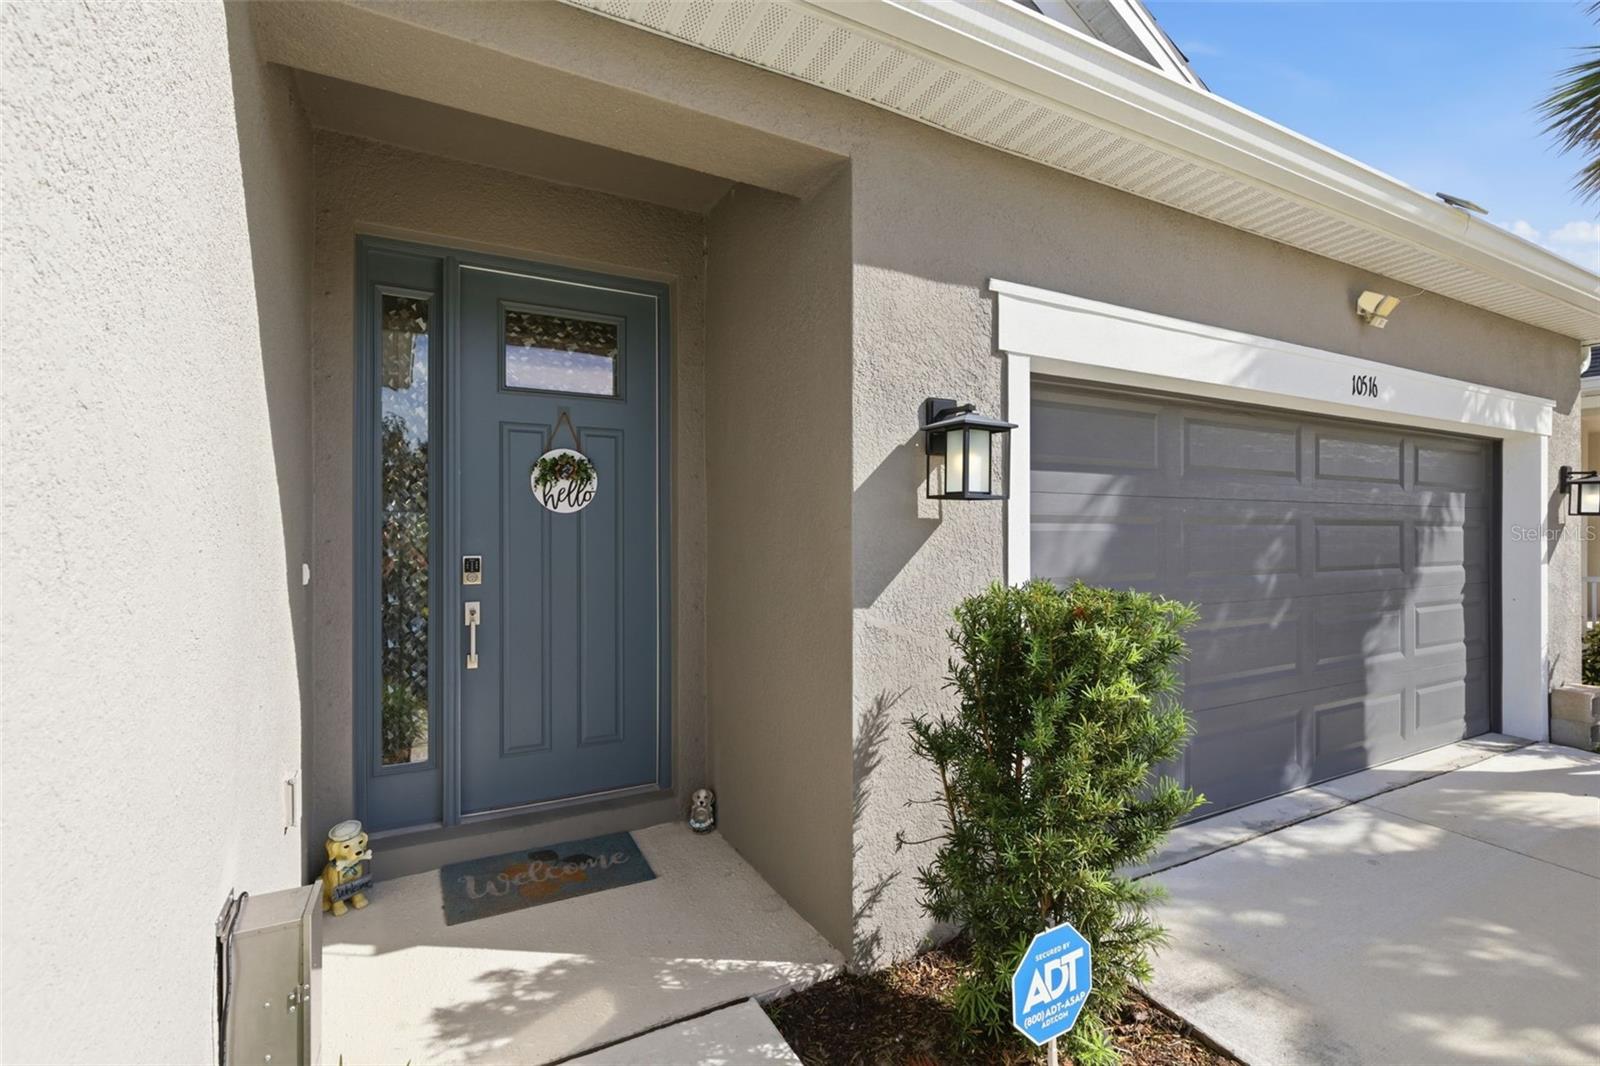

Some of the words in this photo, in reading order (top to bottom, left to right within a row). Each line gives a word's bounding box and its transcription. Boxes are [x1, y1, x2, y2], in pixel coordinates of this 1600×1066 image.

[1352, 374, 1378, 398] 10516
[543, 480, 596, 509] hello
[1035, 944, 1061, 962] SECURED
[1062, 941, 1071, 950] BY
[1022, 947, 1084, 1015] ADT
[1024, 1011, 1045, 1029] (800)
[1045, 991, 1086, 1017] ADT-ASAP
[1041, 1011, 1069, 1029] ADT.COM
